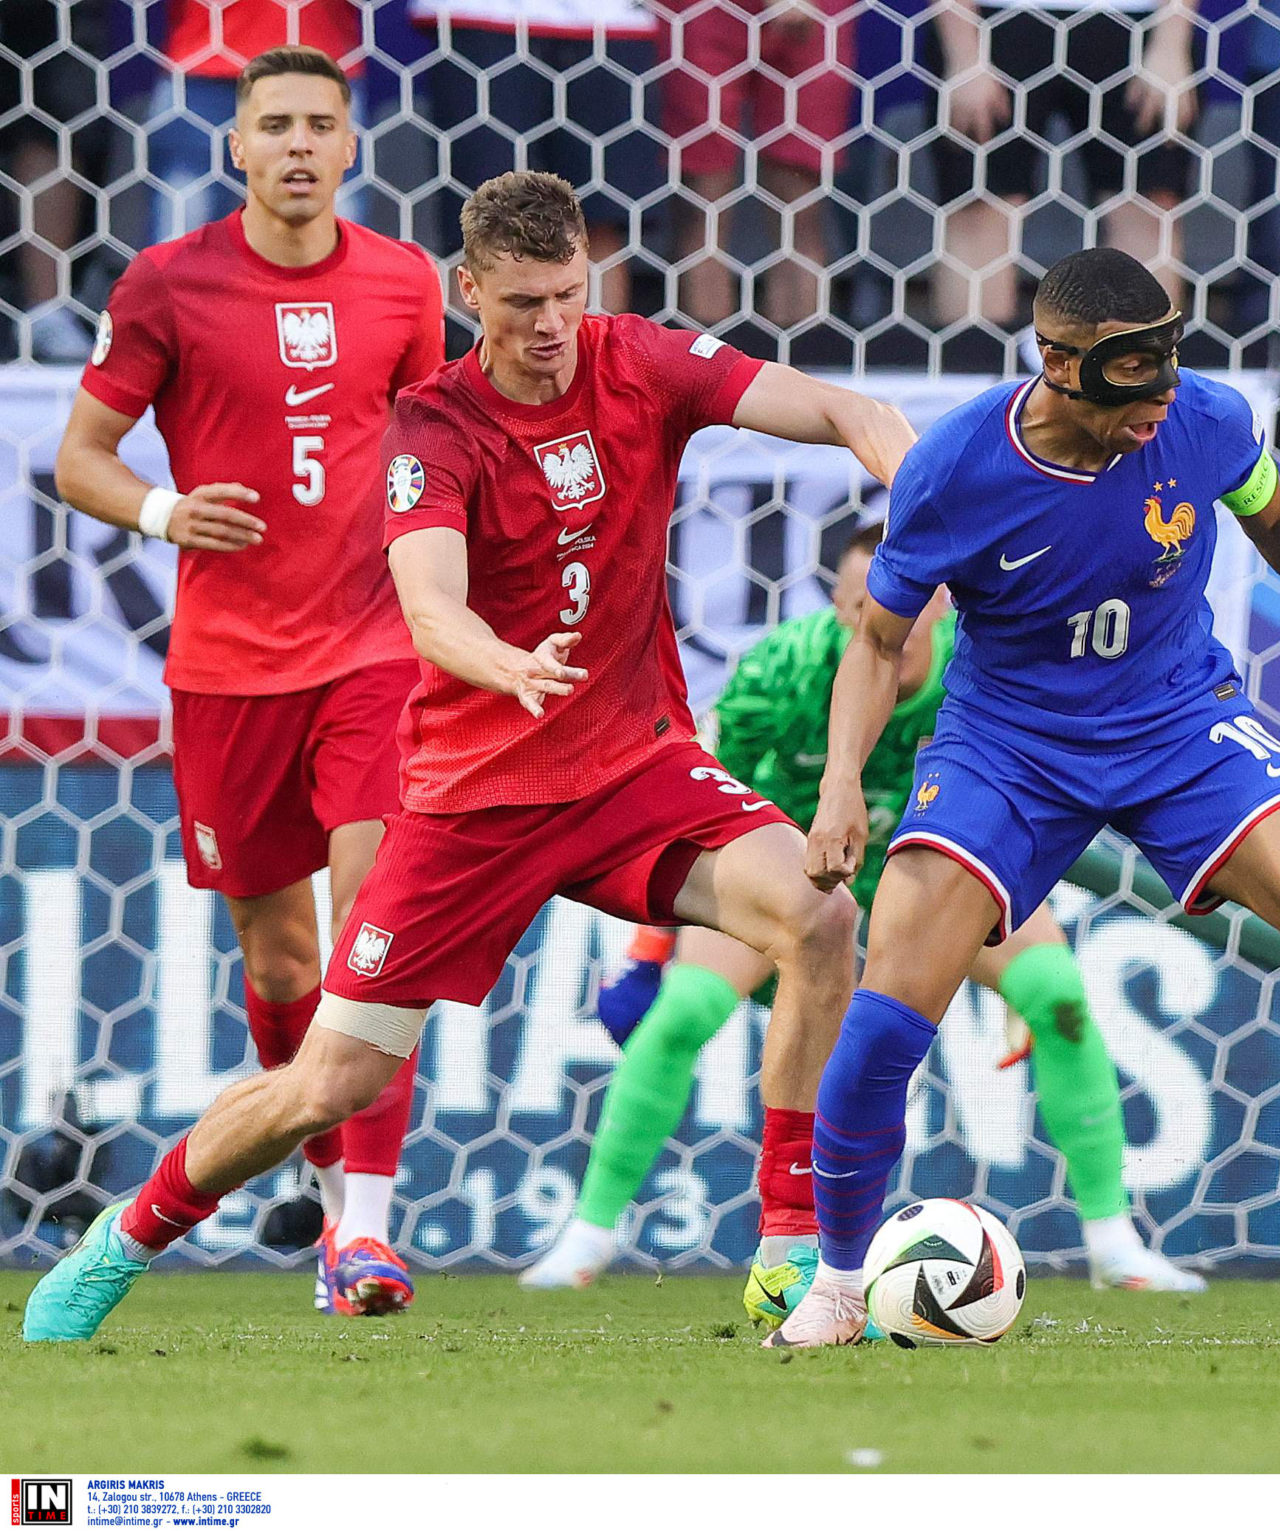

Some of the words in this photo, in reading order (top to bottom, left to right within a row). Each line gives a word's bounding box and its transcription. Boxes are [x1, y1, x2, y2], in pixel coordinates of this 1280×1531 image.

[292, 436, 325, 506] 5
[560, 562, 591, 625] 3
[1067, 598, 1131, 659] 10
[690, 766, 752, 795] 3
